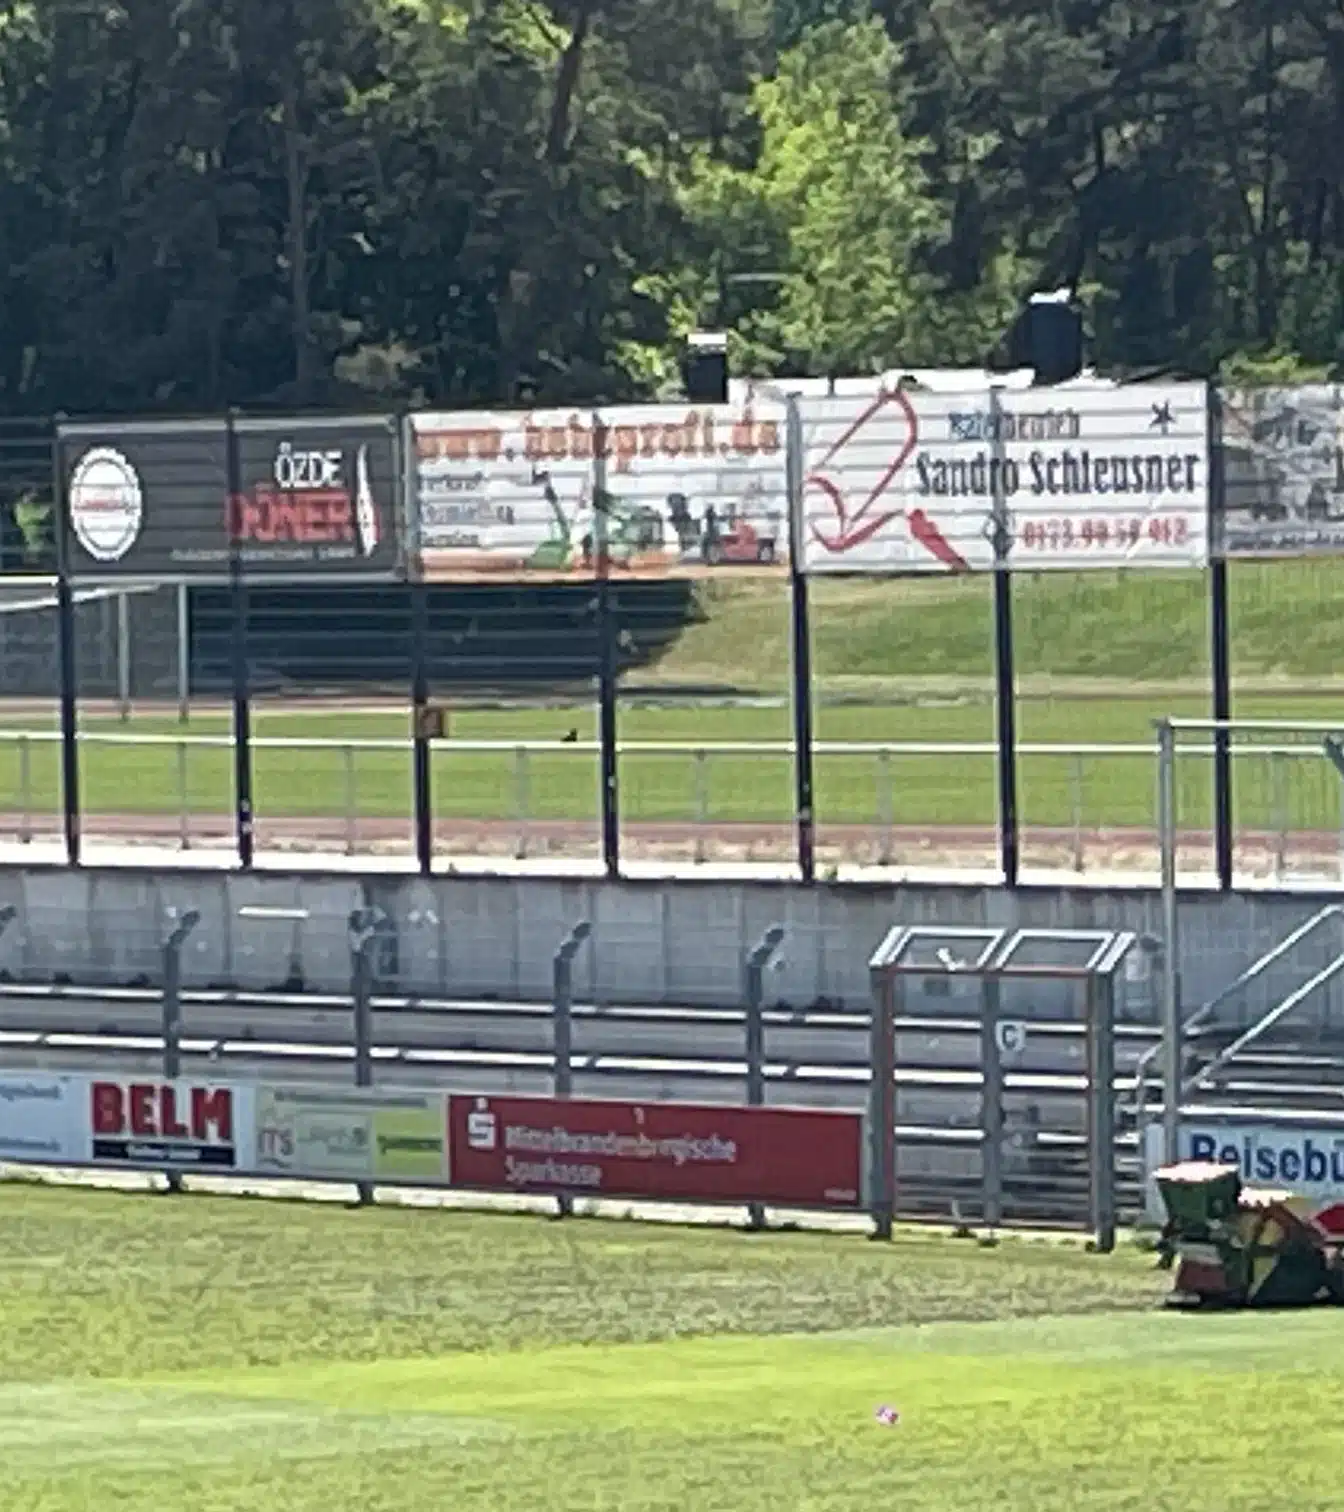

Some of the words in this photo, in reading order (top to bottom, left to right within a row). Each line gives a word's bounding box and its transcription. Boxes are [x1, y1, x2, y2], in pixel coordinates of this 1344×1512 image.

[916, 451, 1020, 496] Sandro
[91, 1082, 233, 1141] BELM
[506, 1155, 603, 1186] Sparkasse
